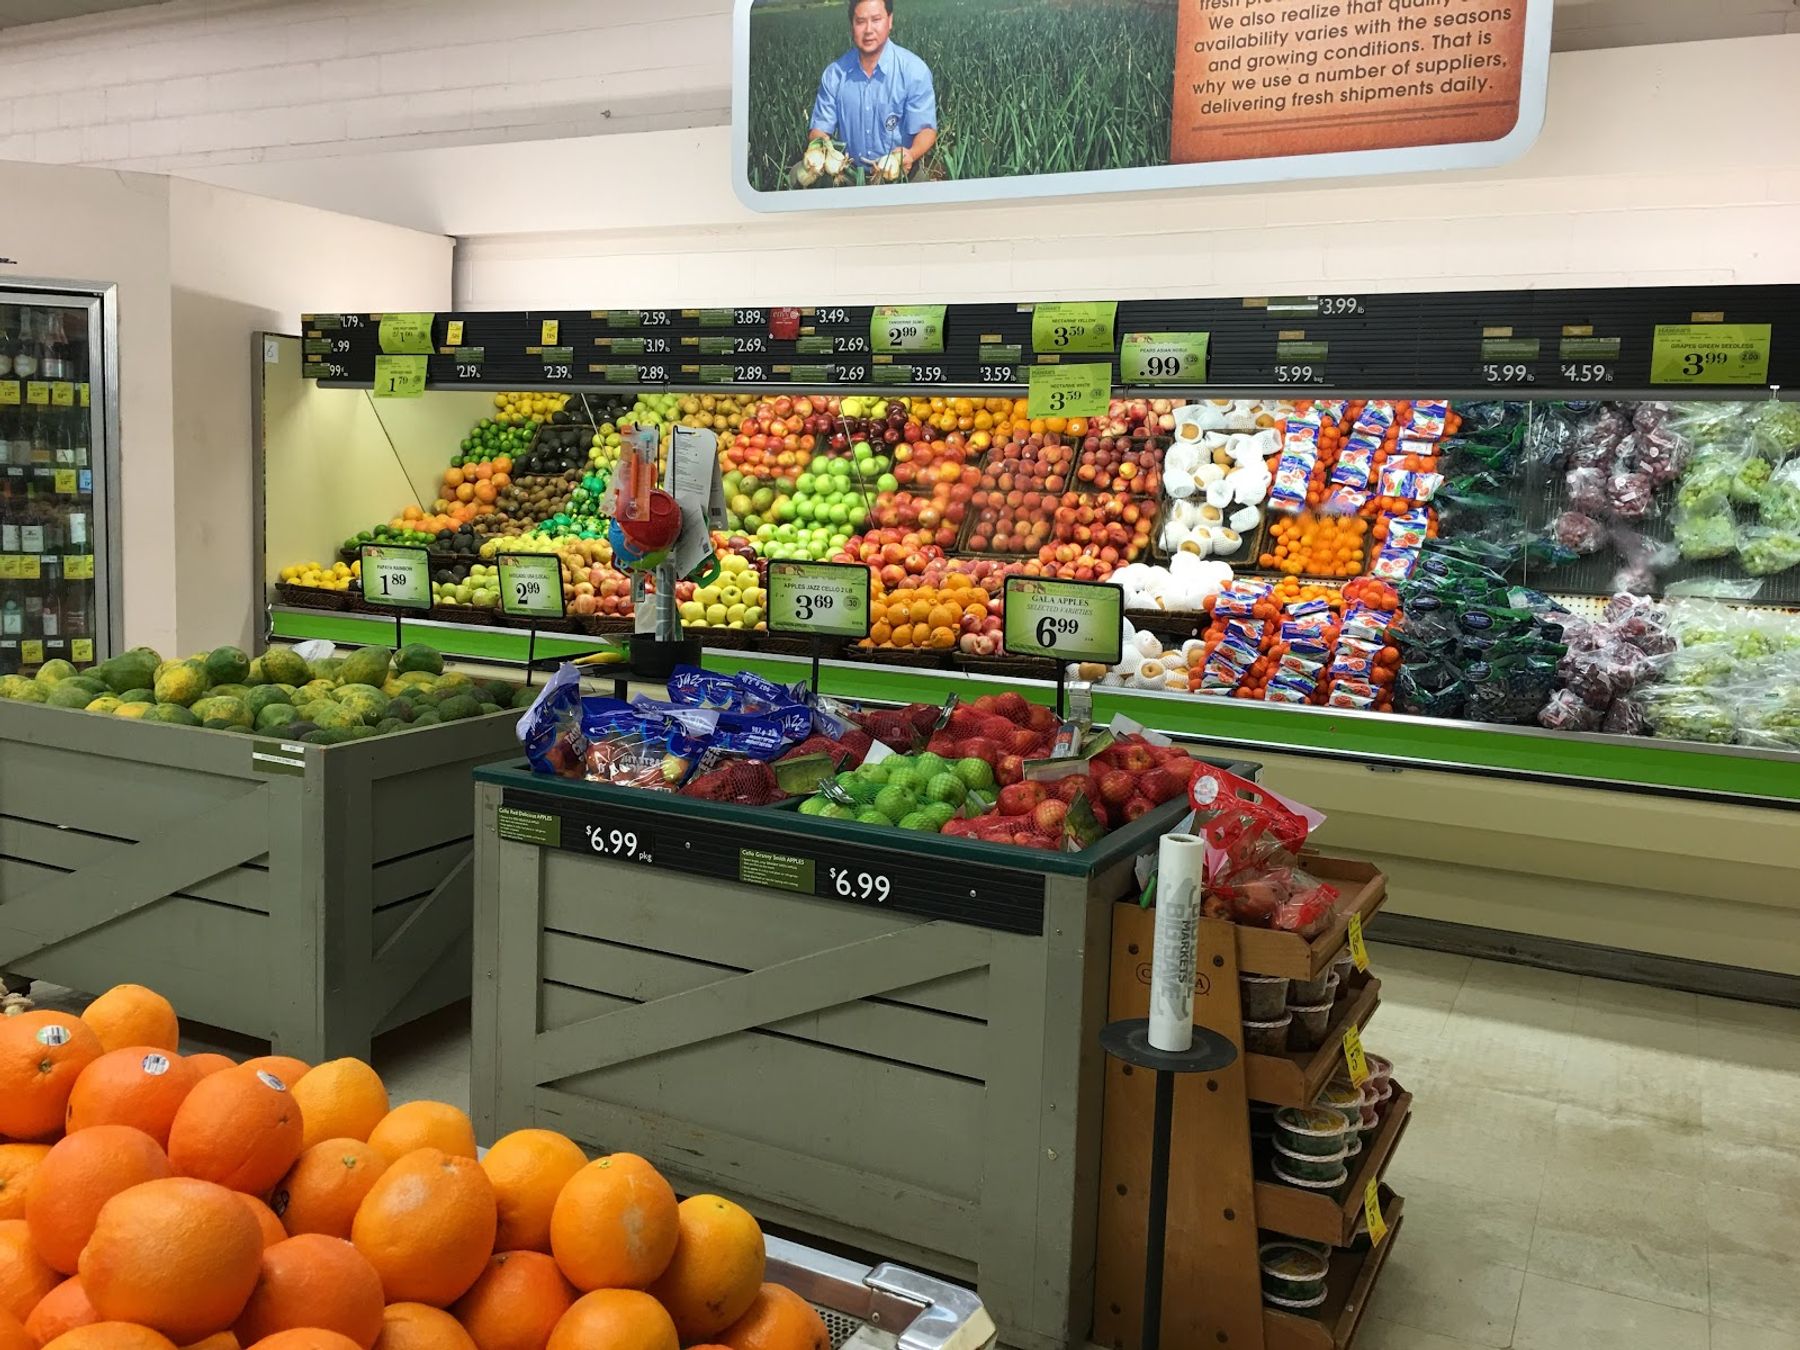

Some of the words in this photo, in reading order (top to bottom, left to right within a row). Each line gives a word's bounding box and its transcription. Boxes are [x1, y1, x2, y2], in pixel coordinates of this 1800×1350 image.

[1209, 16, 1234, 31] We
[1240, 11, 1275, 27] also
[1281, 4, 1341, 23] realize
[1346, 0, 1382, 15] that
[1194, 30, 1289, 53] availability
[1295, 24, 1348, 43] varies
[1354, 18, 1390, 35] with
[1397, 16, 1427, 31] the
[1433, 7, 1512, 28] seasons
[1208, 55, 1241, 73] and
[1246, 50, 1318, 73] growing
[1324, 38, 1425, 61] conditions.
[1432, 31, 1472, 50] That
[1477, 30, 1492, 45] is
[1193, 79, 1226, 96] why
[1231, 78, 1256, 92] we
[1262, 75, 1292, 89] use
[1298, 73, 1309, 85] a
[1316, 63, 1386, 84] number
[1391, 59, 1410, 76] of
[1416, 53, 1507, 75] suppliers,
[1201, 95, 1286, 115] delivering
[1292, 89, 1334, 108] fresh
[1339, 80, 1434, 104] shipments
[1440, 75, 1493, 94] daily.
[1319, 297, 1357, 314] $3.99
[1357, 306, 1365, 315] lb
[640, 311, 665, 326] $2.59
[734, 309, 761, 325] $3.89
[816, 308, 844, 324] $3.49
[643, 338, 665, 353] $3.19
[734, 337, 761, 353] $2.69
[835, 337, 864, 352] $2.69
[457, 365, 477, 378] $2.19
[544, 365, 568, 379] $2.39
[638, 365, 664, 380] $2.89
[735, 366, 762, 380] $2.89
[836, 366, 864, 381] $2.69
[911, 366, 942, 382] $3.59
[980, 366, 1011, 382] $3.59
[1274, 365, 1313, 382] $5.99
[1483, 364, 1527, 382] $5.99
[1527, 374, 1535, 382] lb
[1561, 363, 1605, 382] $4.59
[1605, 374, 1613, 382] lb
[784, 583, 806, 591] APPLES
[1031, 595, 1055, 604] GALA
[1058, 597, 1090, 607] APPLES
[1026, 603, 1059, 613] SELECTED
[1059, 606, 1094, 616] VARIETIES
[585, 824, 639, 857] $6.99
[638, 850, 654, 863] pkg
[829, 867, 891, 903] $6.99
[1178, 919, 1188, 984] MARKETS
